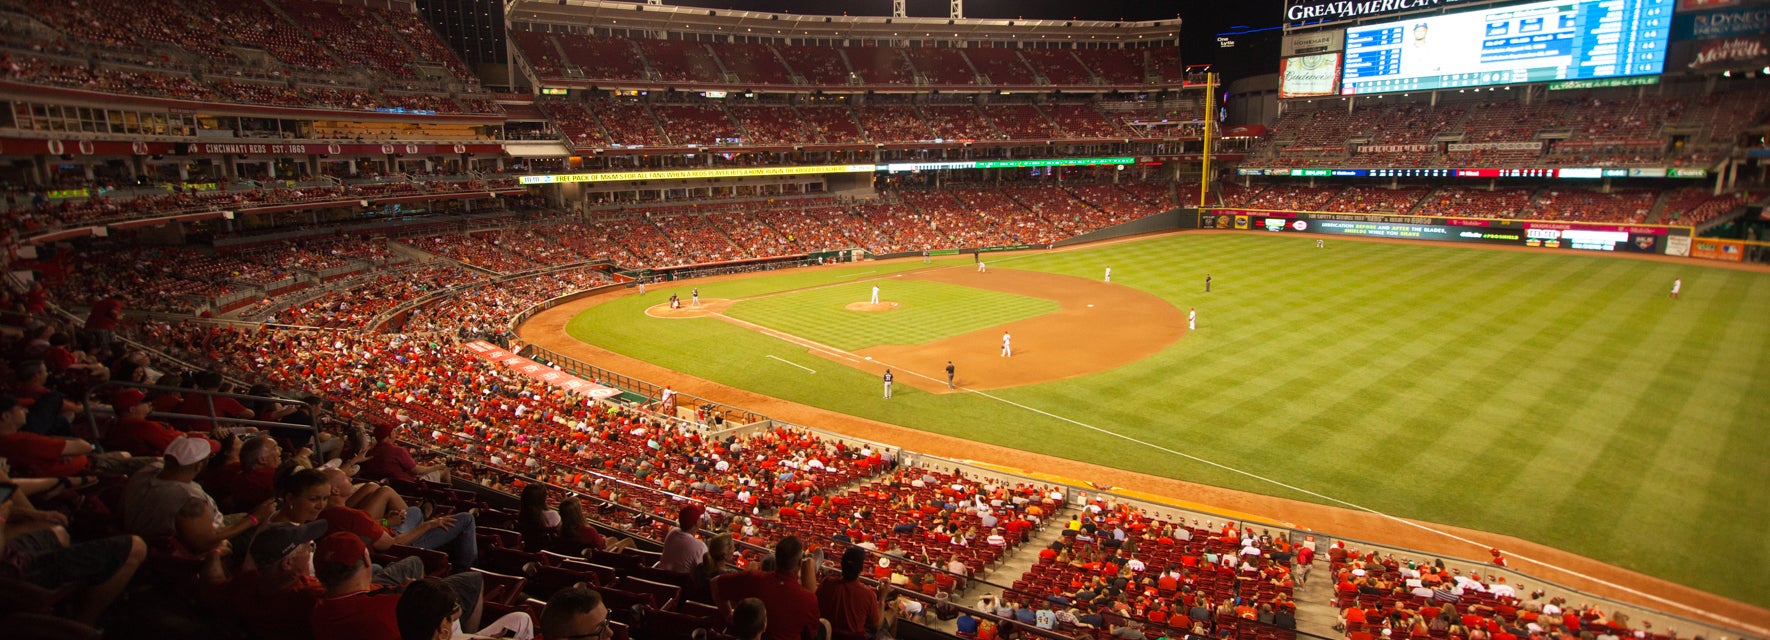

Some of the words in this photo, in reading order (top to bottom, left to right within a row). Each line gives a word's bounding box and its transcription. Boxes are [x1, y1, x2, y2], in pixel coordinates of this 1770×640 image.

[1294, 37, 1330, 46] HOMEMADE
[205, 144, 247, 153] CINCINNATI
[249, 144, 267, 153] REDS
[272, 144, 287, 153] EST.
[289, 144, 306, 153] 1869
